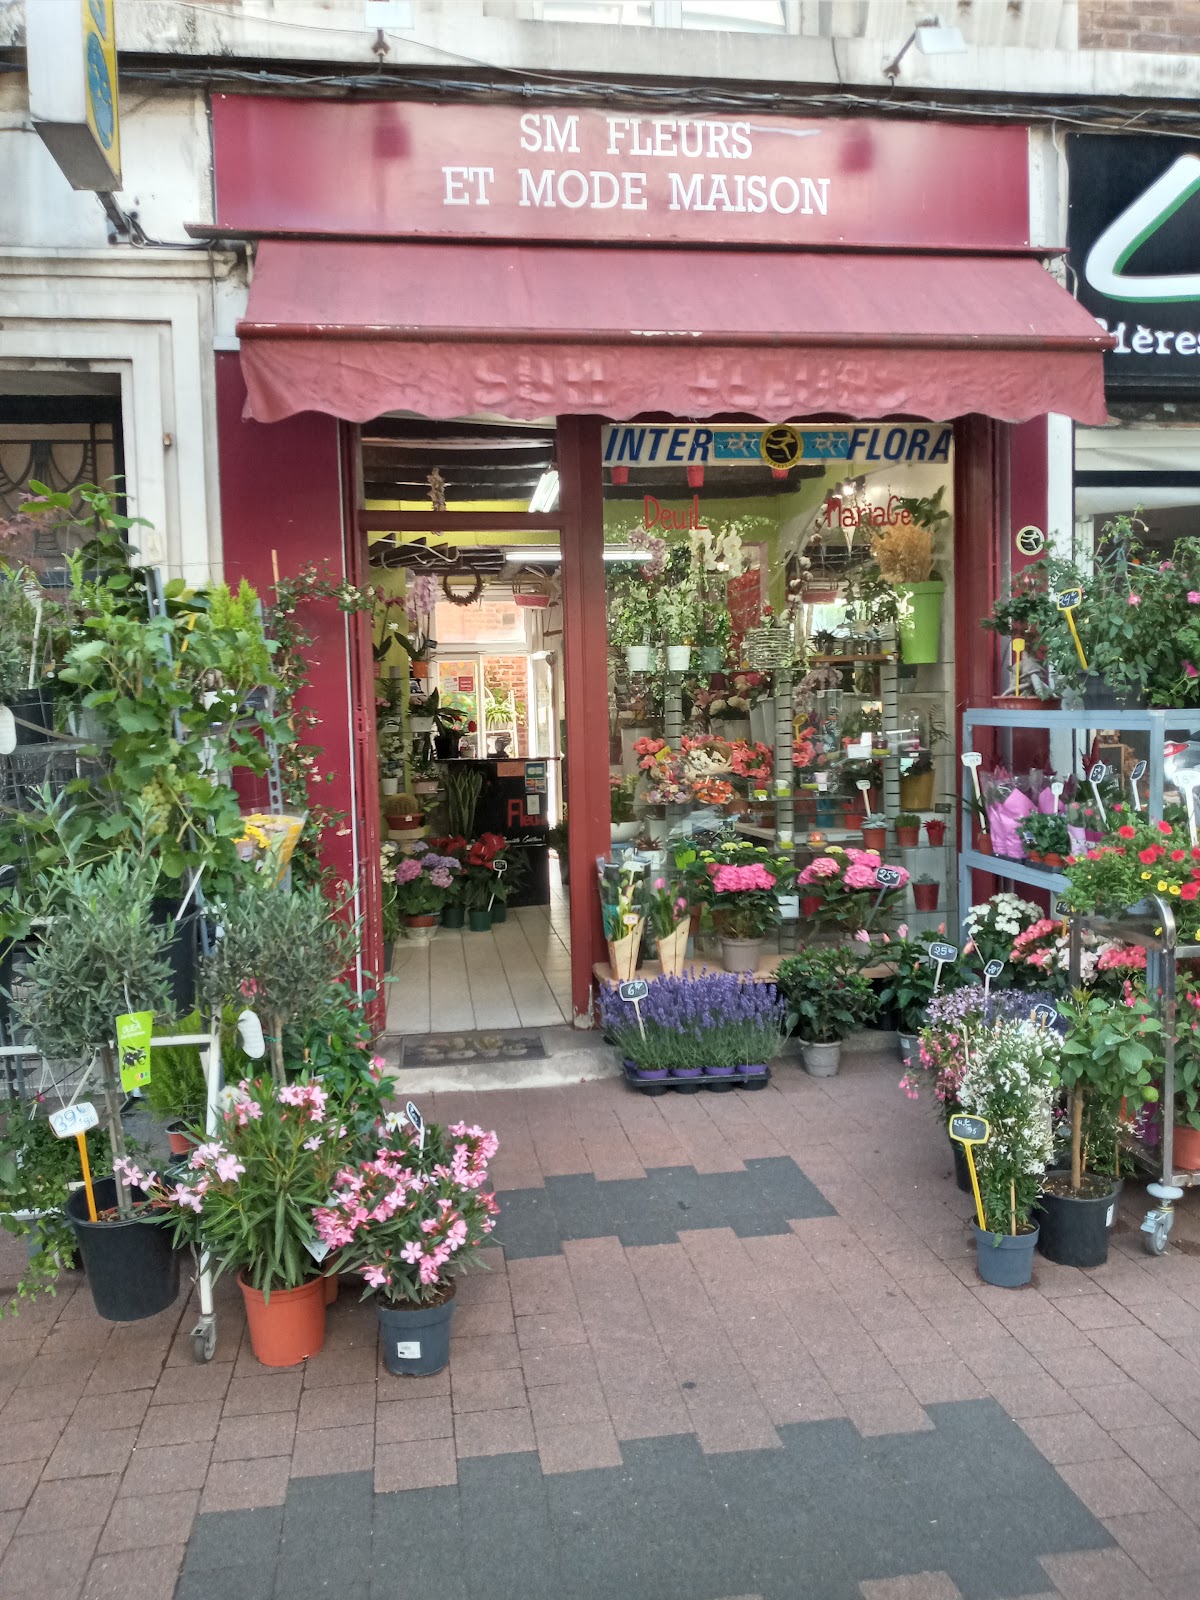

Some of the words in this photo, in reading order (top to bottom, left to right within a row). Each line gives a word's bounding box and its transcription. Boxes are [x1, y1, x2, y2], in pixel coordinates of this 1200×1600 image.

[520, 113, 581, 153] SM
[606, 117, 753, 160] FLEURS
[441, 166, 495, 206] ET
[518, 168, 648, 211] MODE
[668, 172, 831, 216] MAISON
[1094, 317, 1200, 356] ière
[604, 428, 714, 462] INTER
[846, 427, 952, 461] FLORA
